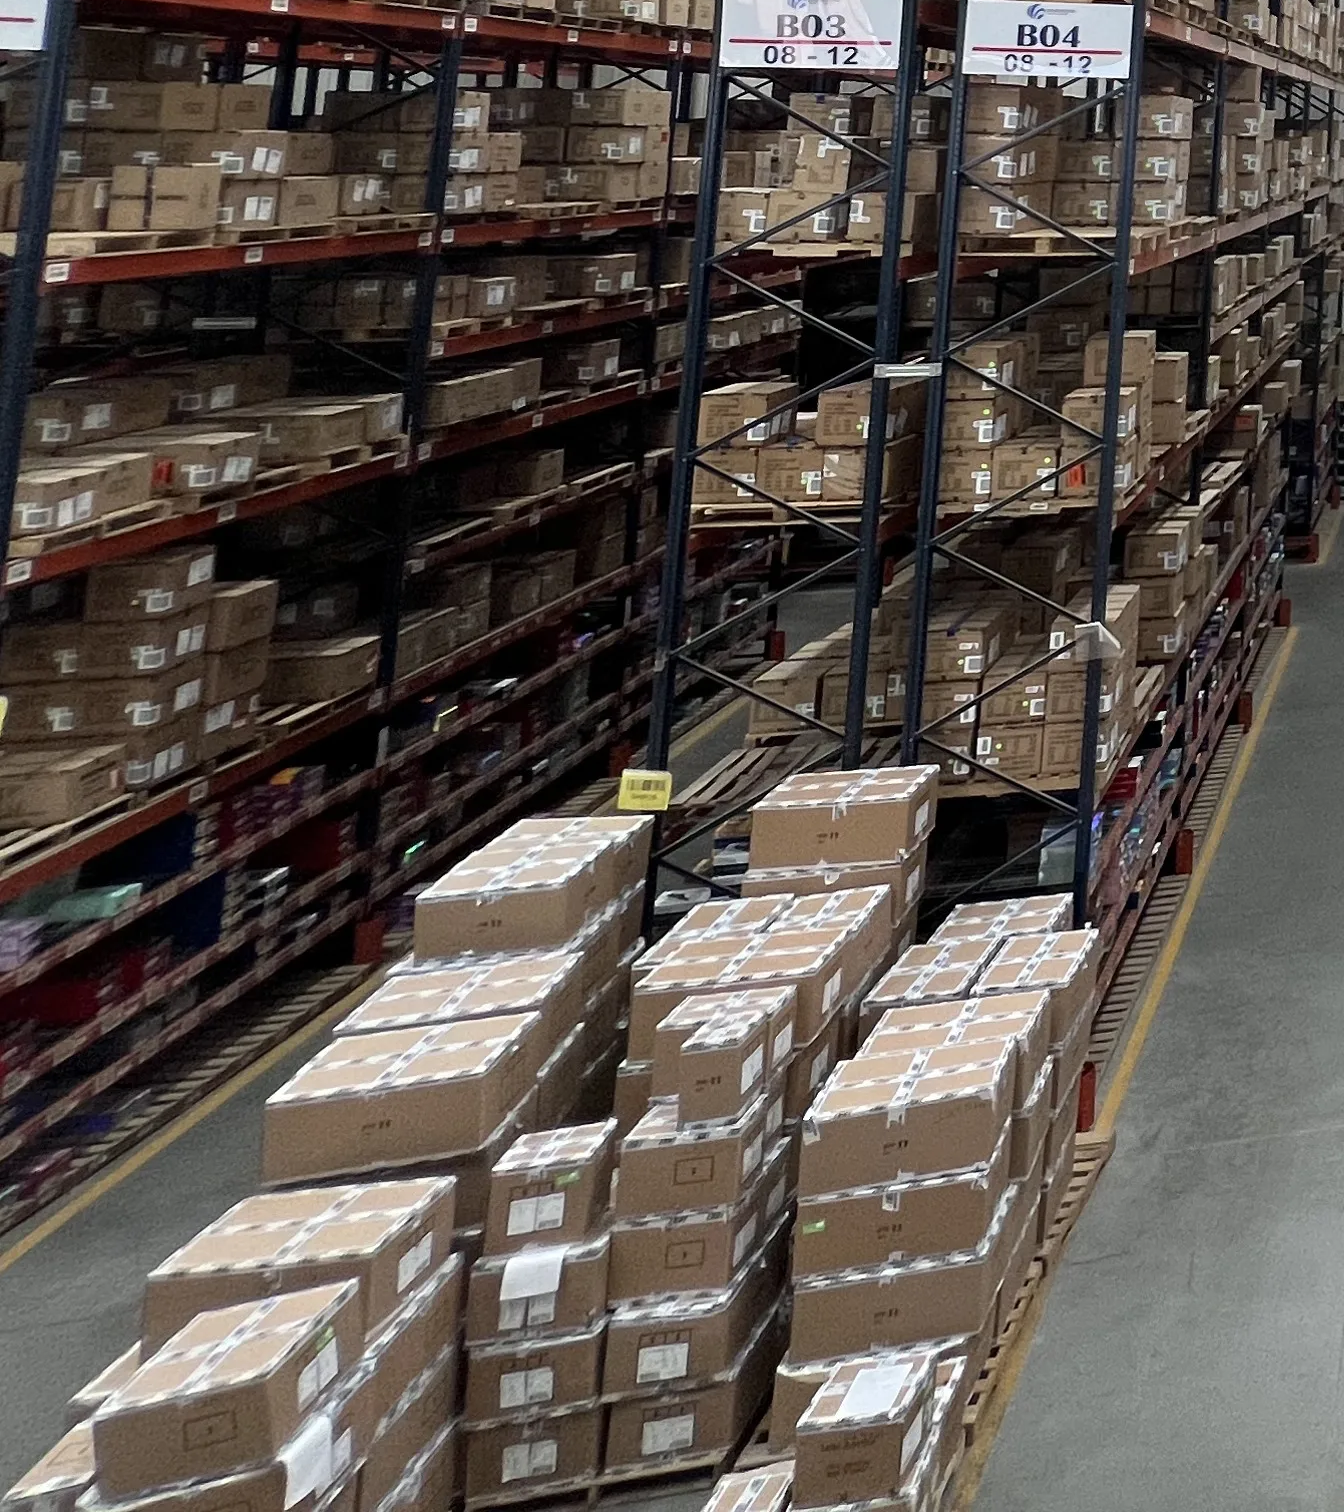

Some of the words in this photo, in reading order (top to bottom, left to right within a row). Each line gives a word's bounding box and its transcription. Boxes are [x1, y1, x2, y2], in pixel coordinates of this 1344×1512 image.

[776, 14, 846, 39] B03
[1016, 23, 1081, 48] B04
[763, 45, 796, 66] 08
[827, 45, 860, 66] 12
